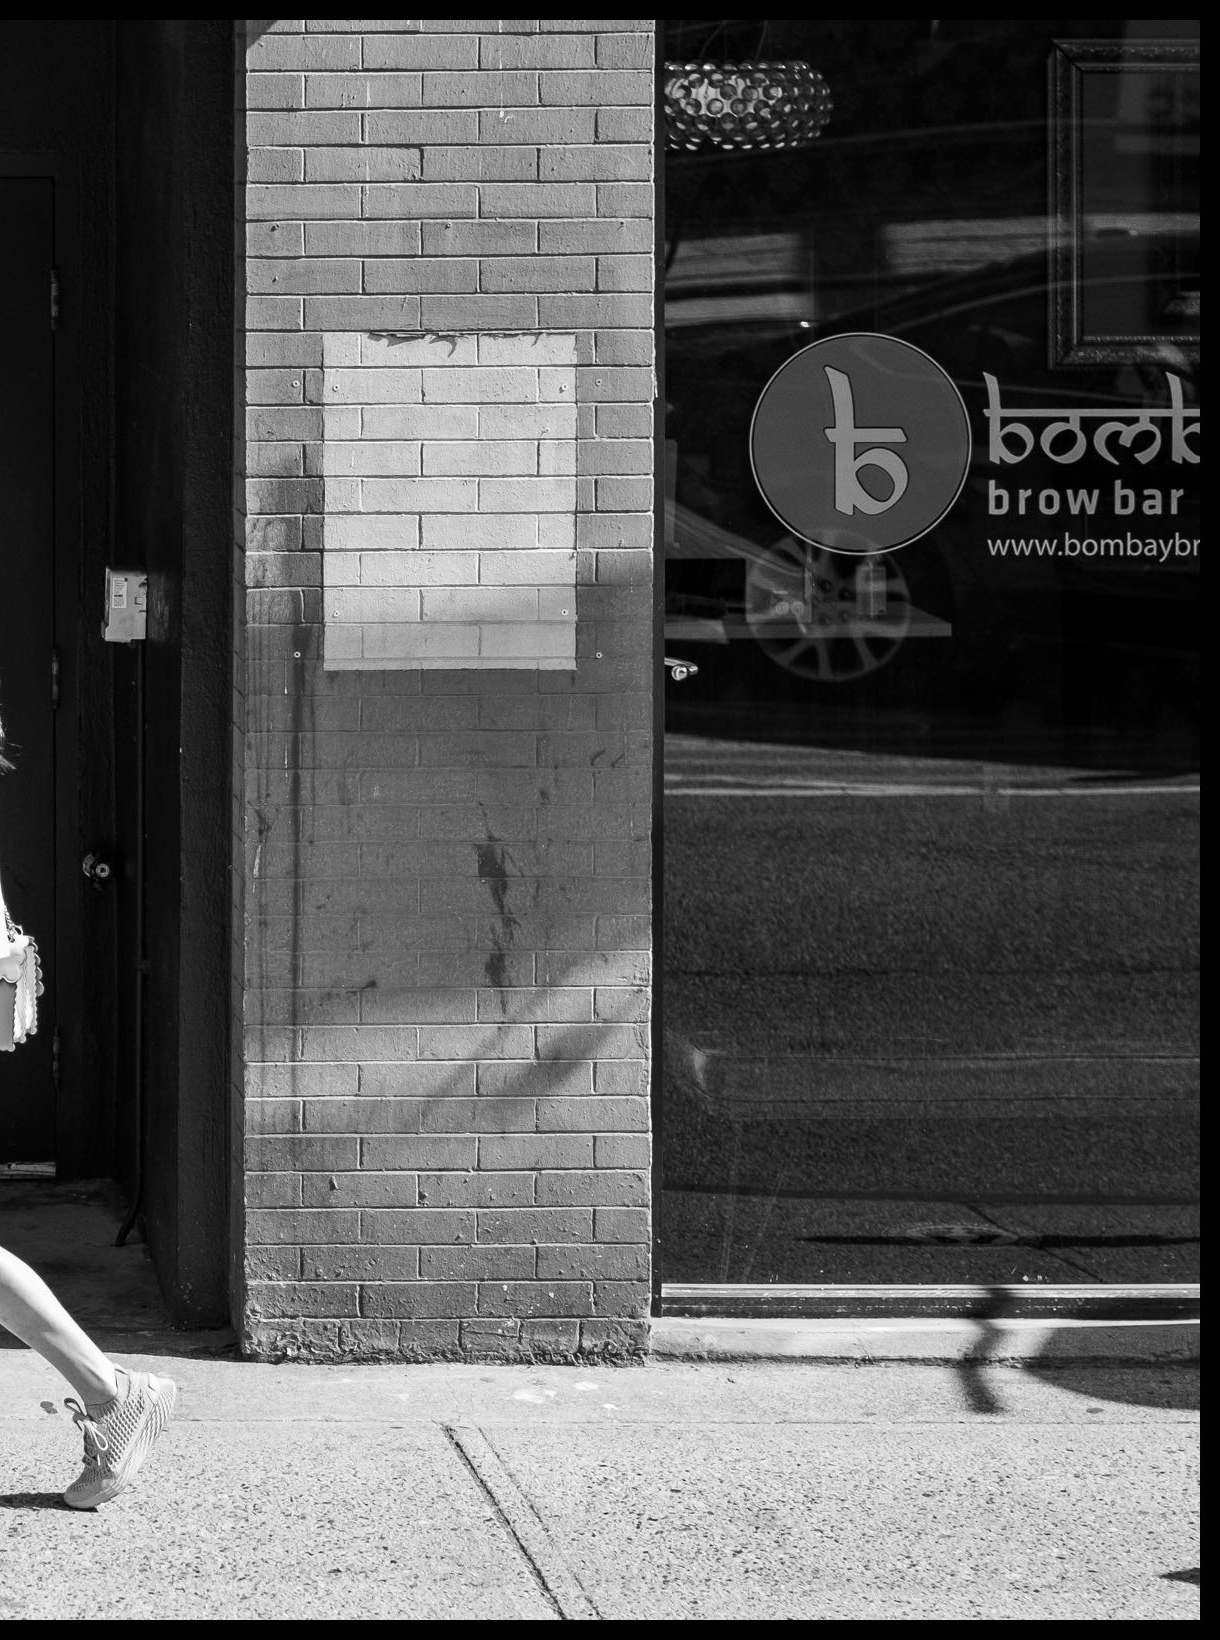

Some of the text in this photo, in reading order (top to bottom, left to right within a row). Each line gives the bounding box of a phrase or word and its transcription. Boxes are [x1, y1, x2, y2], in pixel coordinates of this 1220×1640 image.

[988, 480, 1185, 515] brow bar
[987, 532, 1200, 563] www.bombaybr
